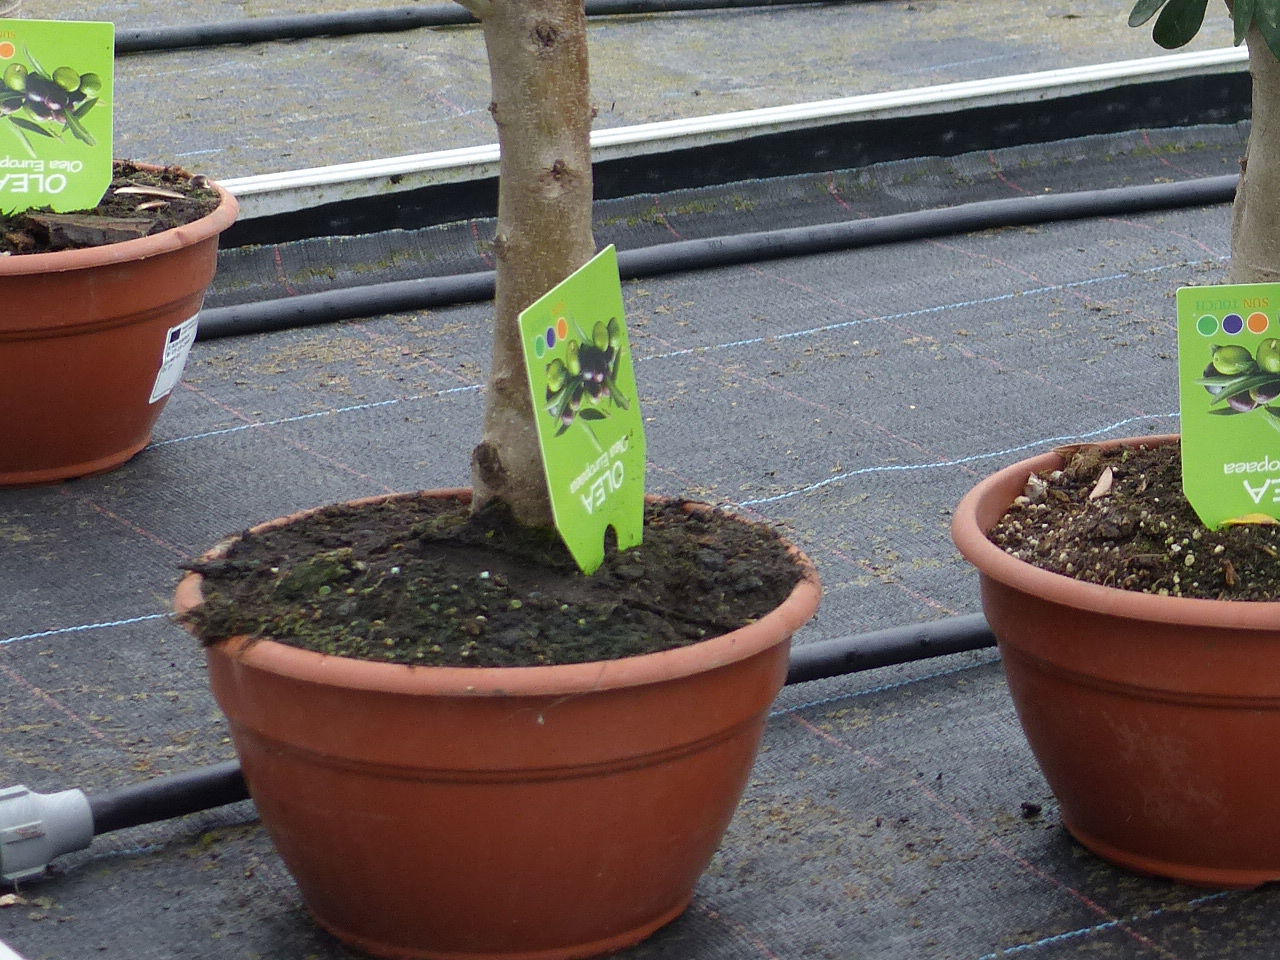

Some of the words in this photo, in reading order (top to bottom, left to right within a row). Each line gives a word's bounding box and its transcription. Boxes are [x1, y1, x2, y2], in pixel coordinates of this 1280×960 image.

[49, 159, 83, 173] Olea
[1195, 299, 1239, 311] TOUCH
[1243, 297, 1270, 309] SUN
[580, 460, 624, 515] OLEA
